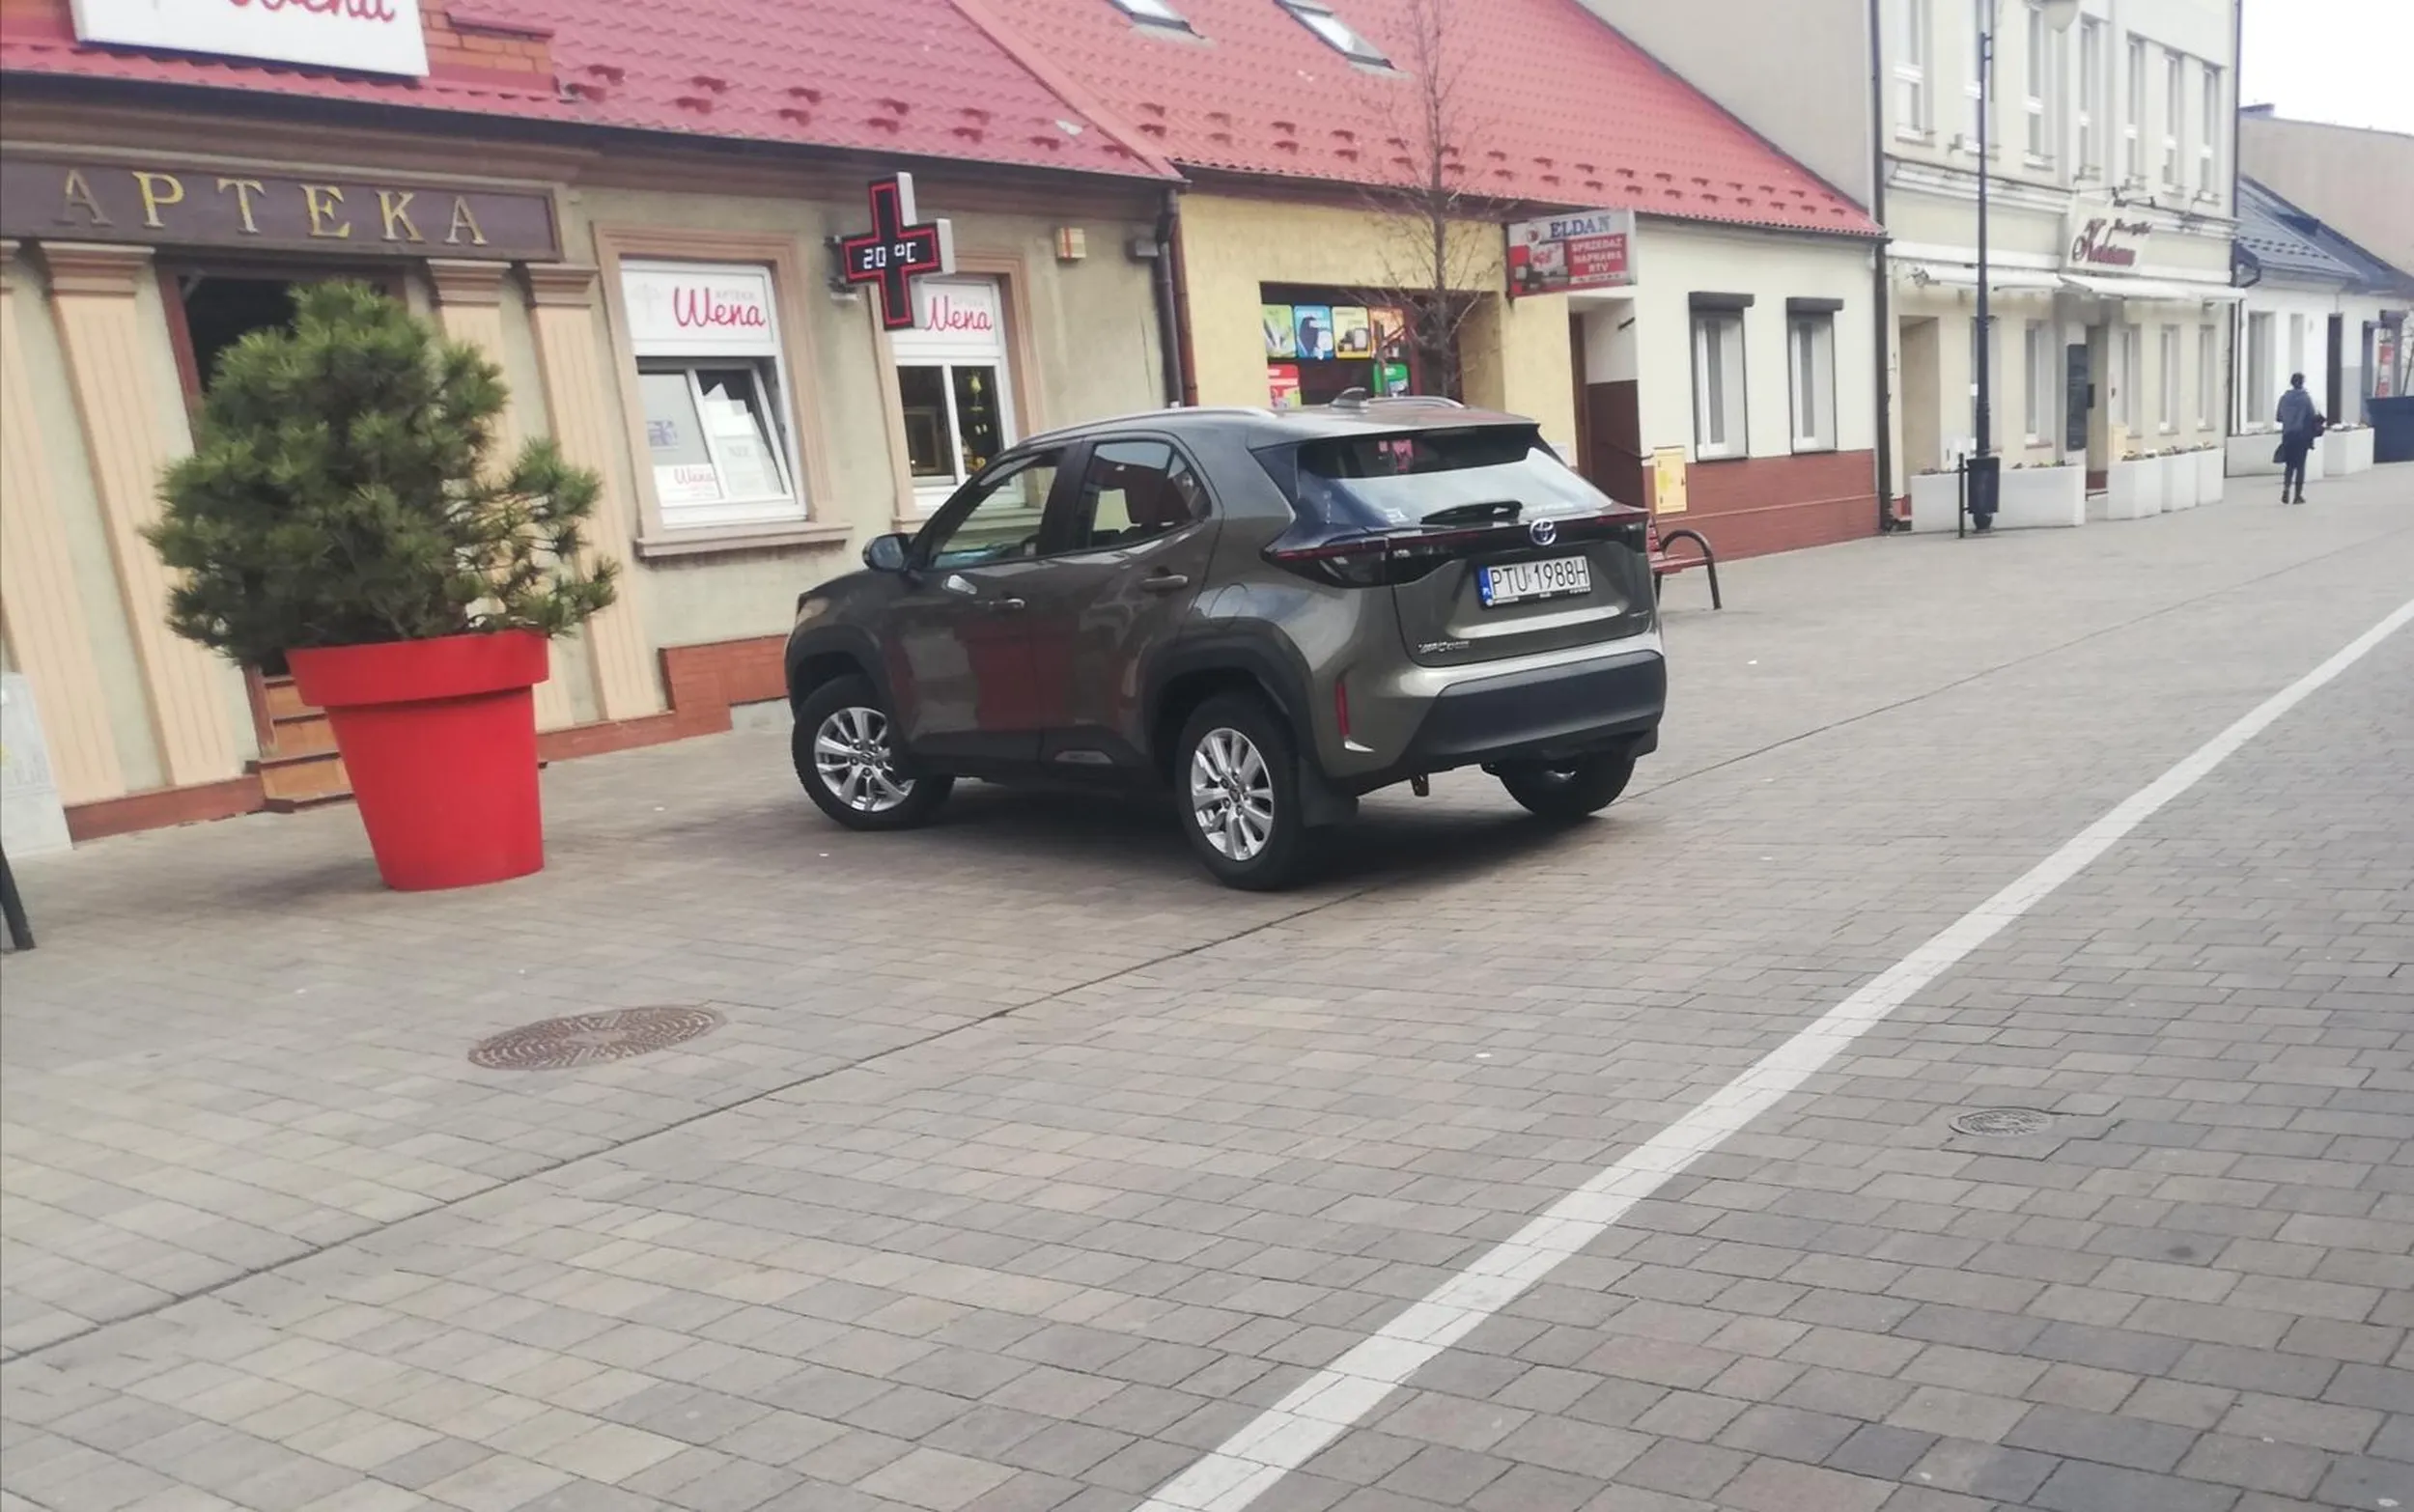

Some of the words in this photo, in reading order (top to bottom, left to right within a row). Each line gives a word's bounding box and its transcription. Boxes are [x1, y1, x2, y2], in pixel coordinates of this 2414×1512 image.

[52, 168, 489, 246] APTEKA
[1549, 214, 1612, 239] ELDAN
[862, 246, 887, 270] 20
[673, 286, 766, 328] Wena
[1490, 565, 1529, 597] PTU
[1533, 559, 1589, 591] 1988H
